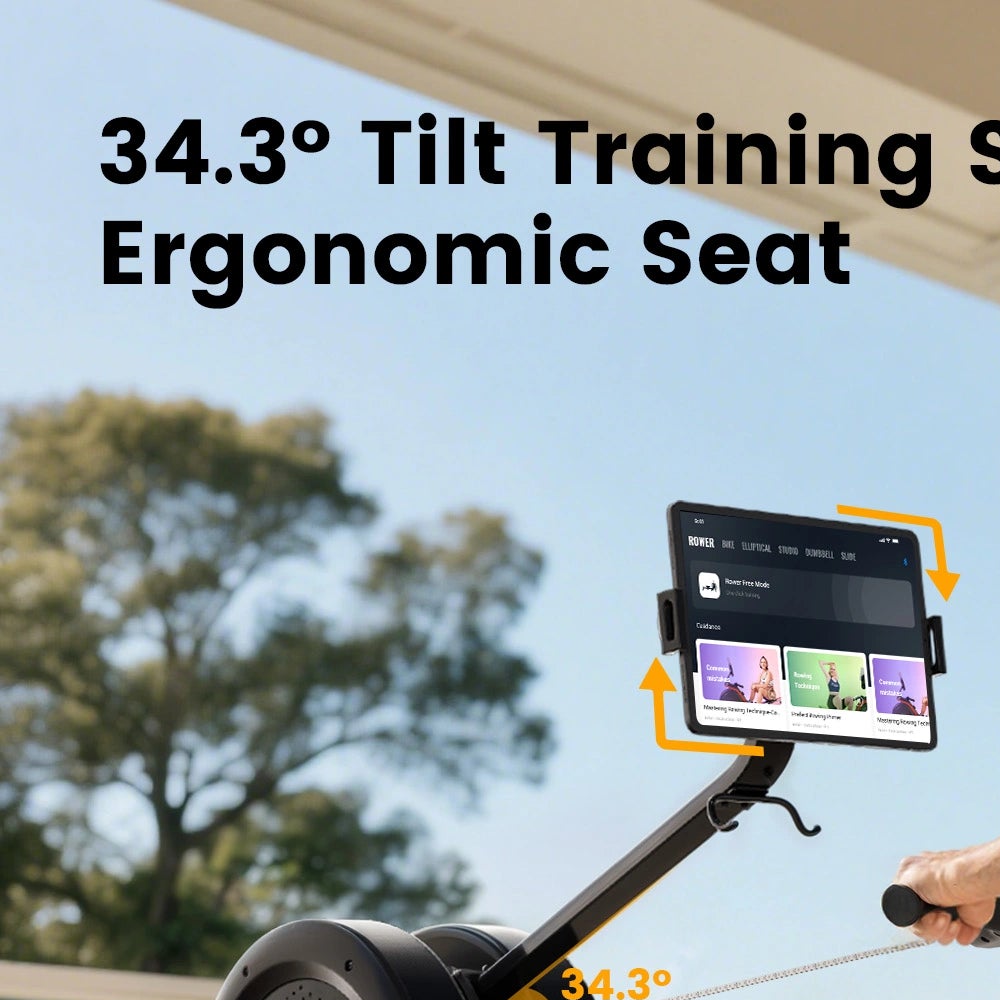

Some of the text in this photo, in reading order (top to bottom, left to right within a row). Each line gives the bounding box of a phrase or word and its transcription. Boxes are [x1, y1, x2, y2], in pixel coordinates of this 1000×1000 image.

[688, 536, 715, 548] ROWER
[721, 540, 735, 550] BIKE
[741, 542, 772, 553] ELLIPTICAL
[778, 545, 799, 556] STUDIO
[805, 548, 834, 559] DUMBBELL
[725, 578, 742, 586] Rower
[755, 581, 770, 589] Mode
[696, 623, 721, 631] Guidance
